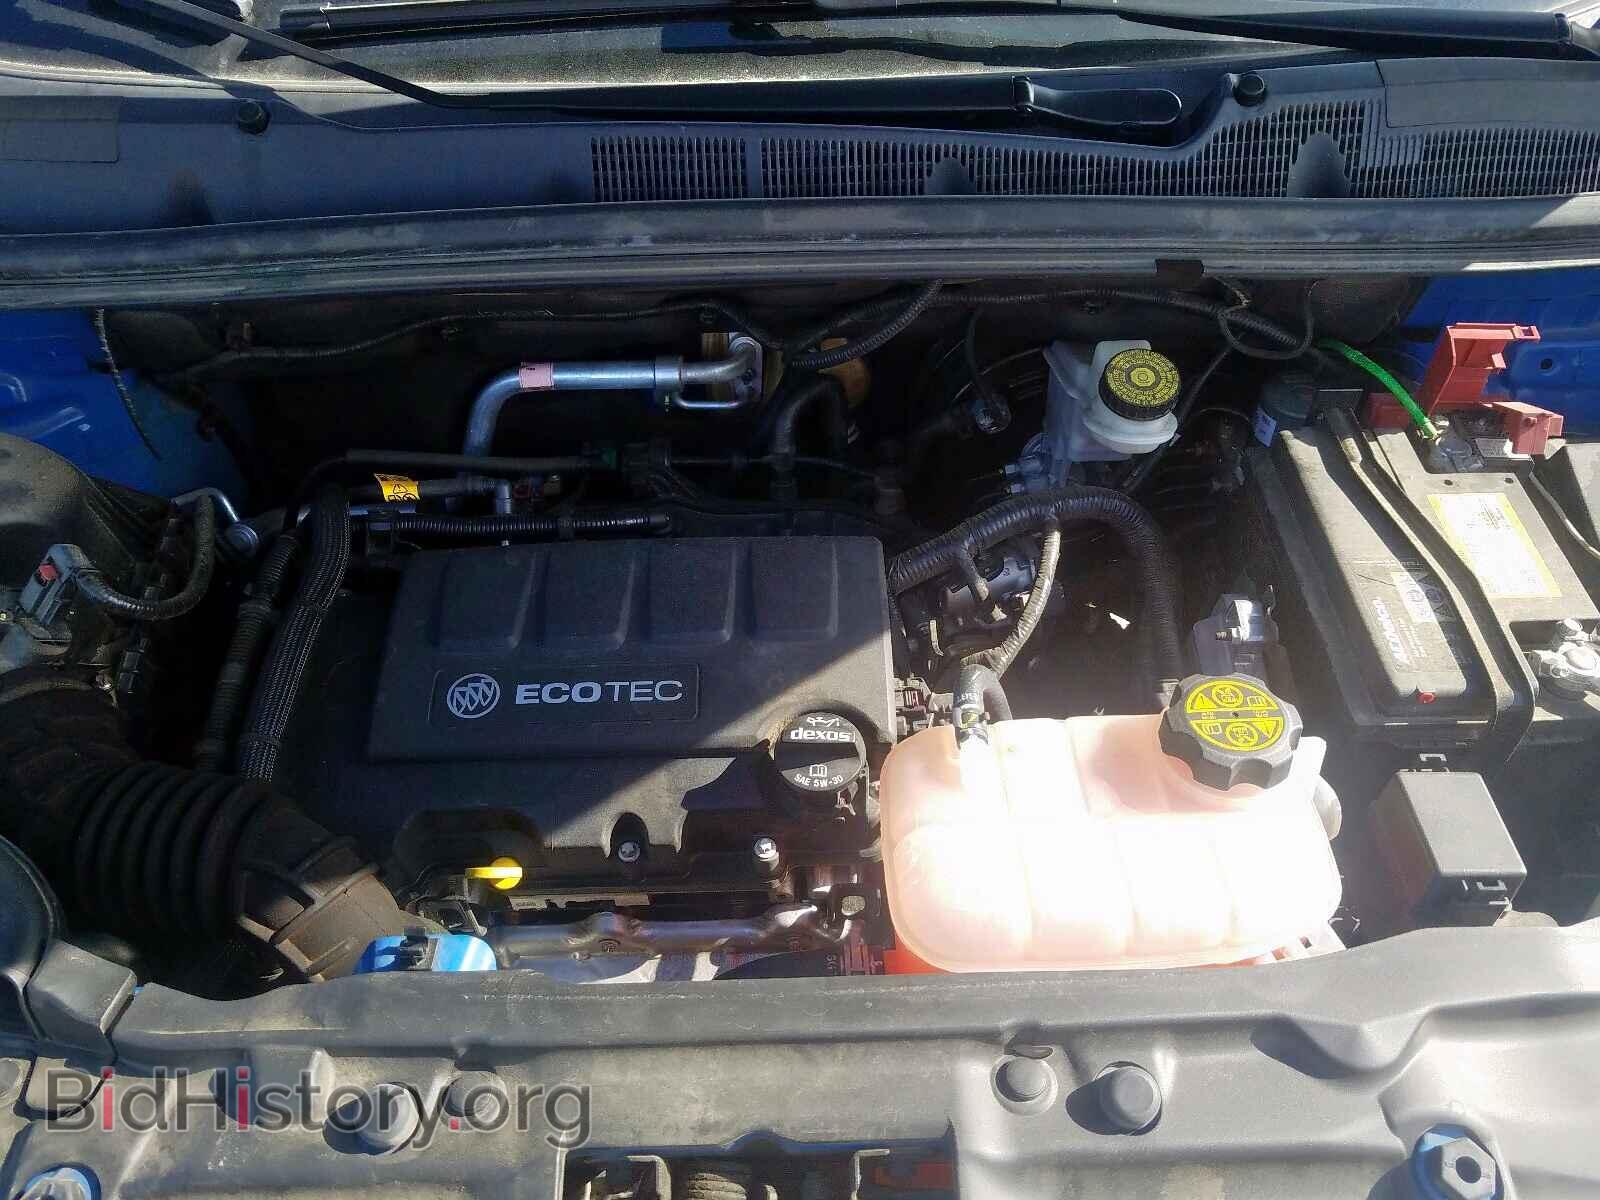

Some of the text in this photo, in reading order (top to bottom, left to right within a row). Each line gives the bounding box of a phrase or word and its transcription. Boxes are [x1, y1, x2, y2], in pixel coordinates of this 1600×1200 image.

[515, 680, 683, 705] ECOTEC
[791, 727, 850, 742] dexos
[794, 773, 844, 787] SAE 5W-30
